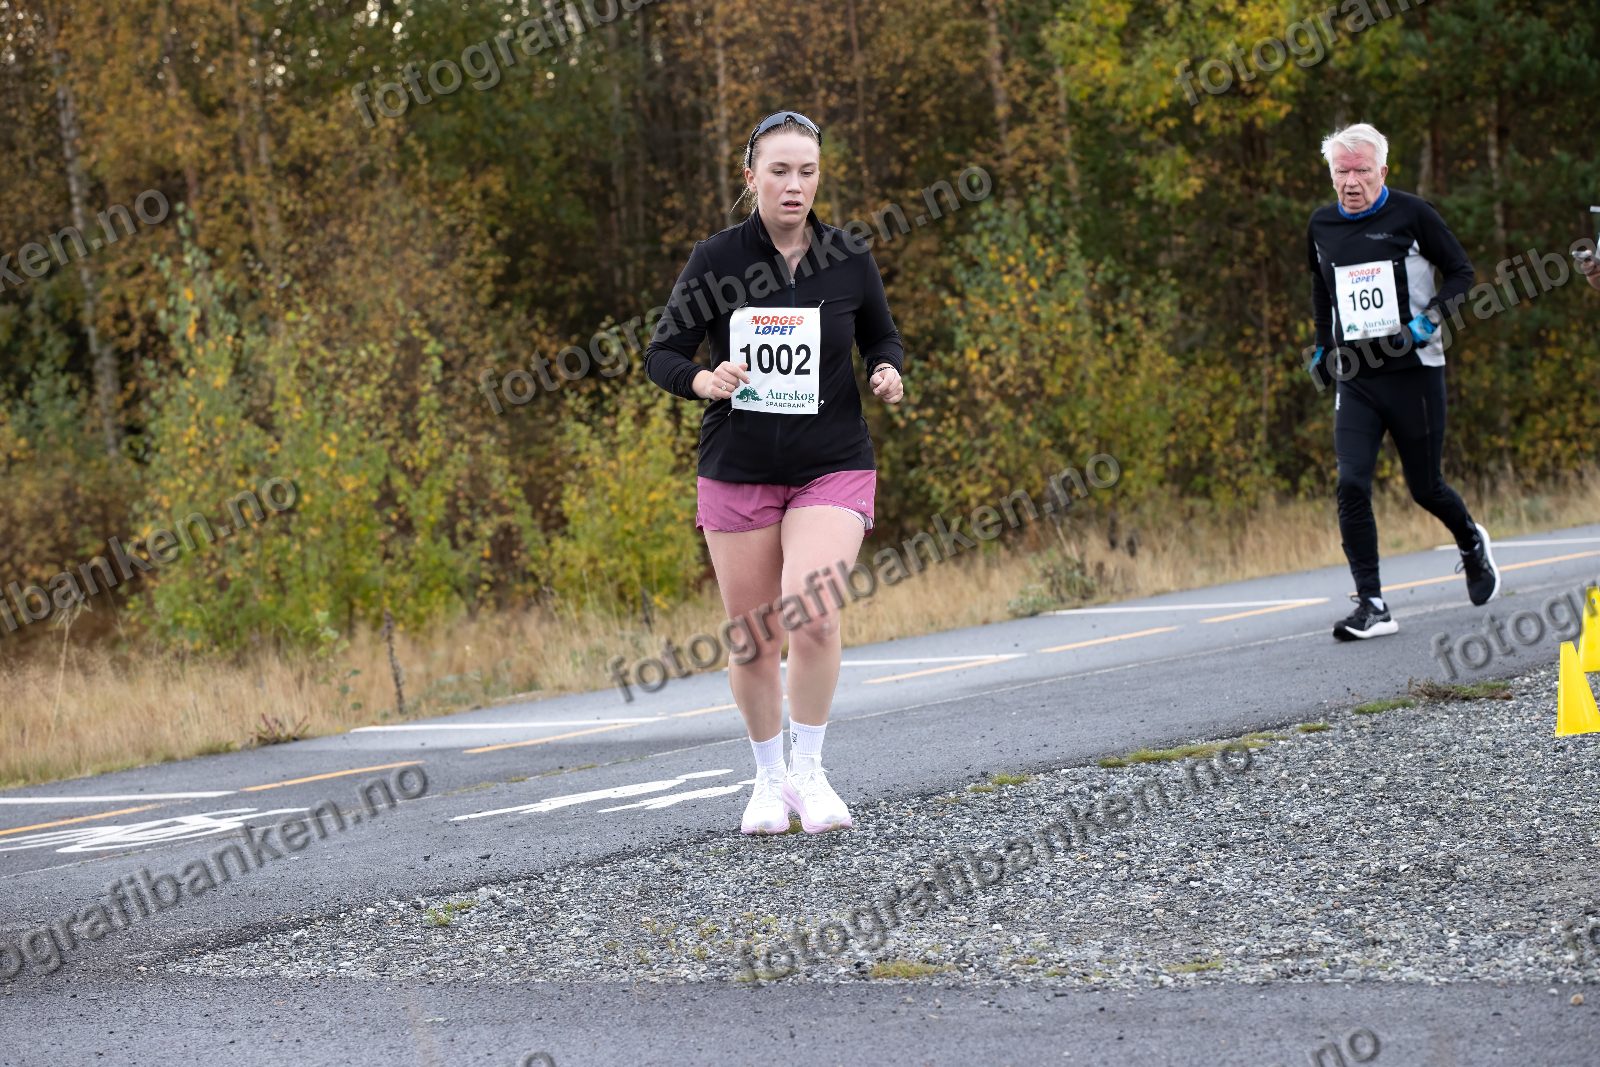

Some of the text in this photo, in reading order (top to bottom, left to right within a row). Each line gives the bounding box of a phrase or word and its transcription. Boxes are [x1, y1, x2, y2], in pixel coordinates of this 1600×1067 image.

[1348, 267, 1382, 278] NORGES
[1348, 287, 1384, 311] 160
[751, 315, 805, 326] NORGES
[755, 325, 796, 335] LØPET
[740, 344, 811, 375] 1002
[766, 389, 815, 403] Aurskog
